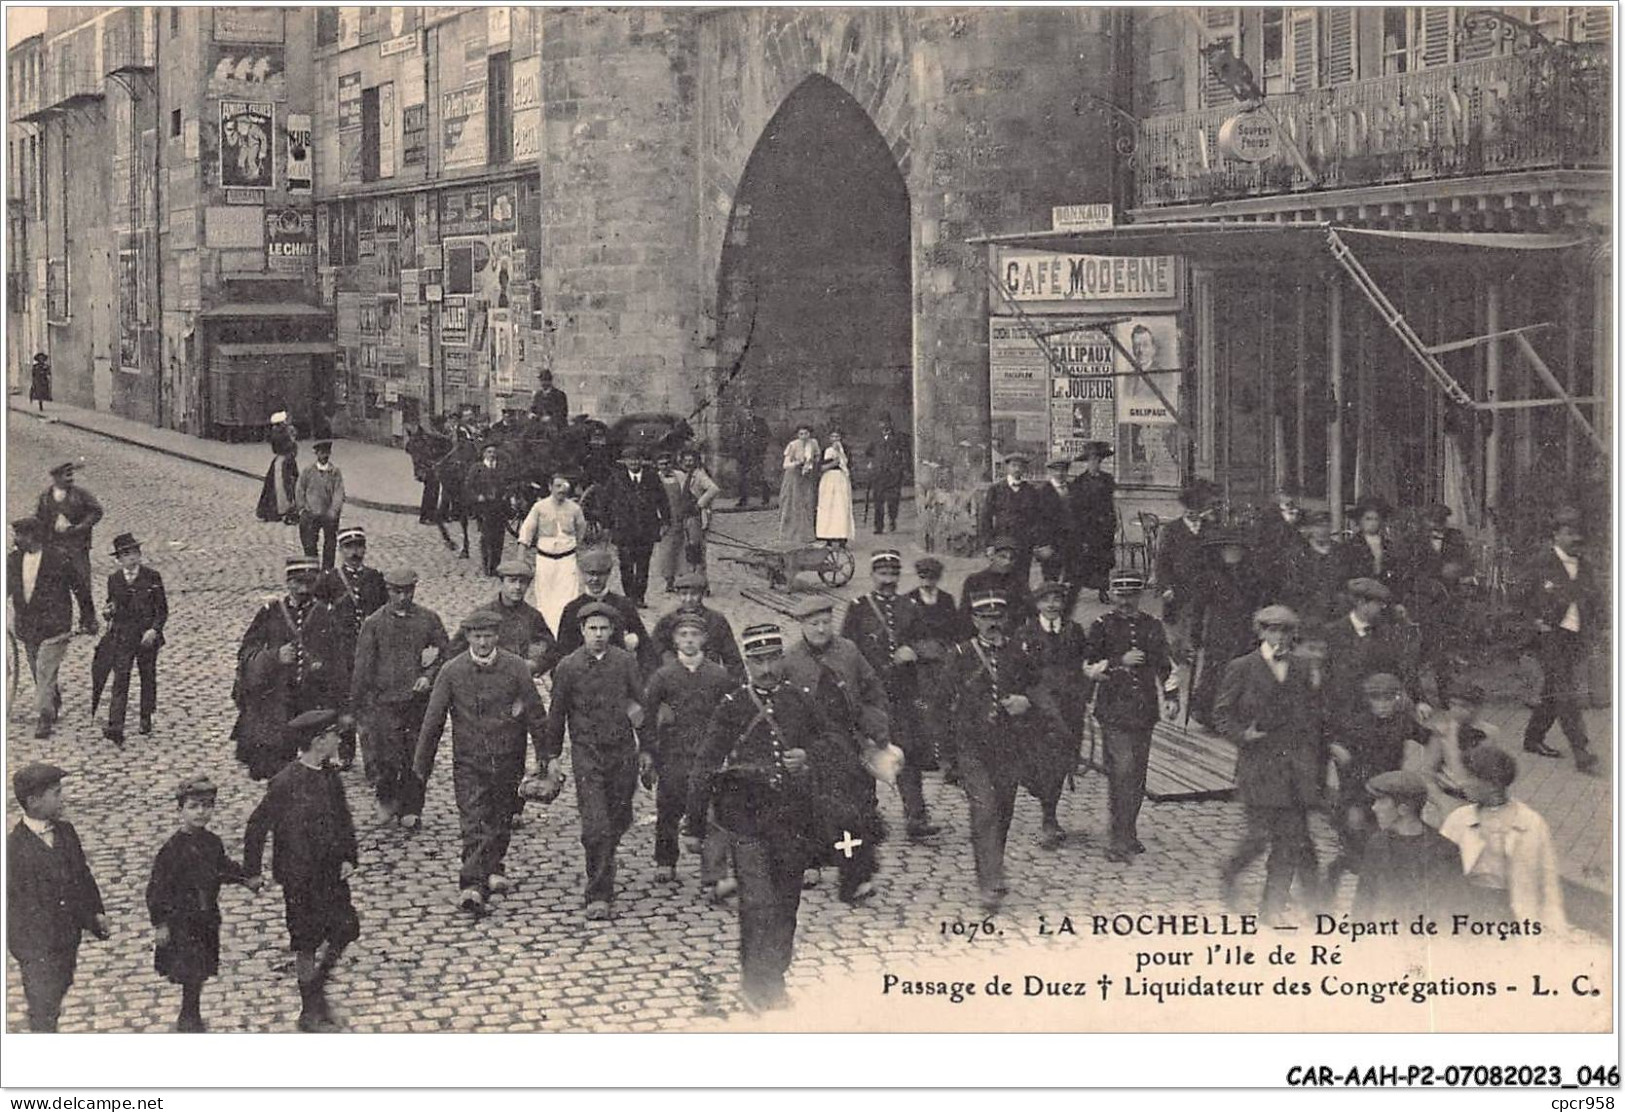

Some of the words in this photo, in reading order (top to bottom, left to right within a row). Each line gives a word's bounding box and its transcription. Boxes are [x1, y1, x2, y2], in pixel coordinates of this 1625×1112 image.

[289, 130, 312, 147] KUB
[1006, 258, 1063, 296] CAFÉ
[1063, 257, 1169, 299] MODERNE
[1065, 379, 1113, 399] JOUEUR
